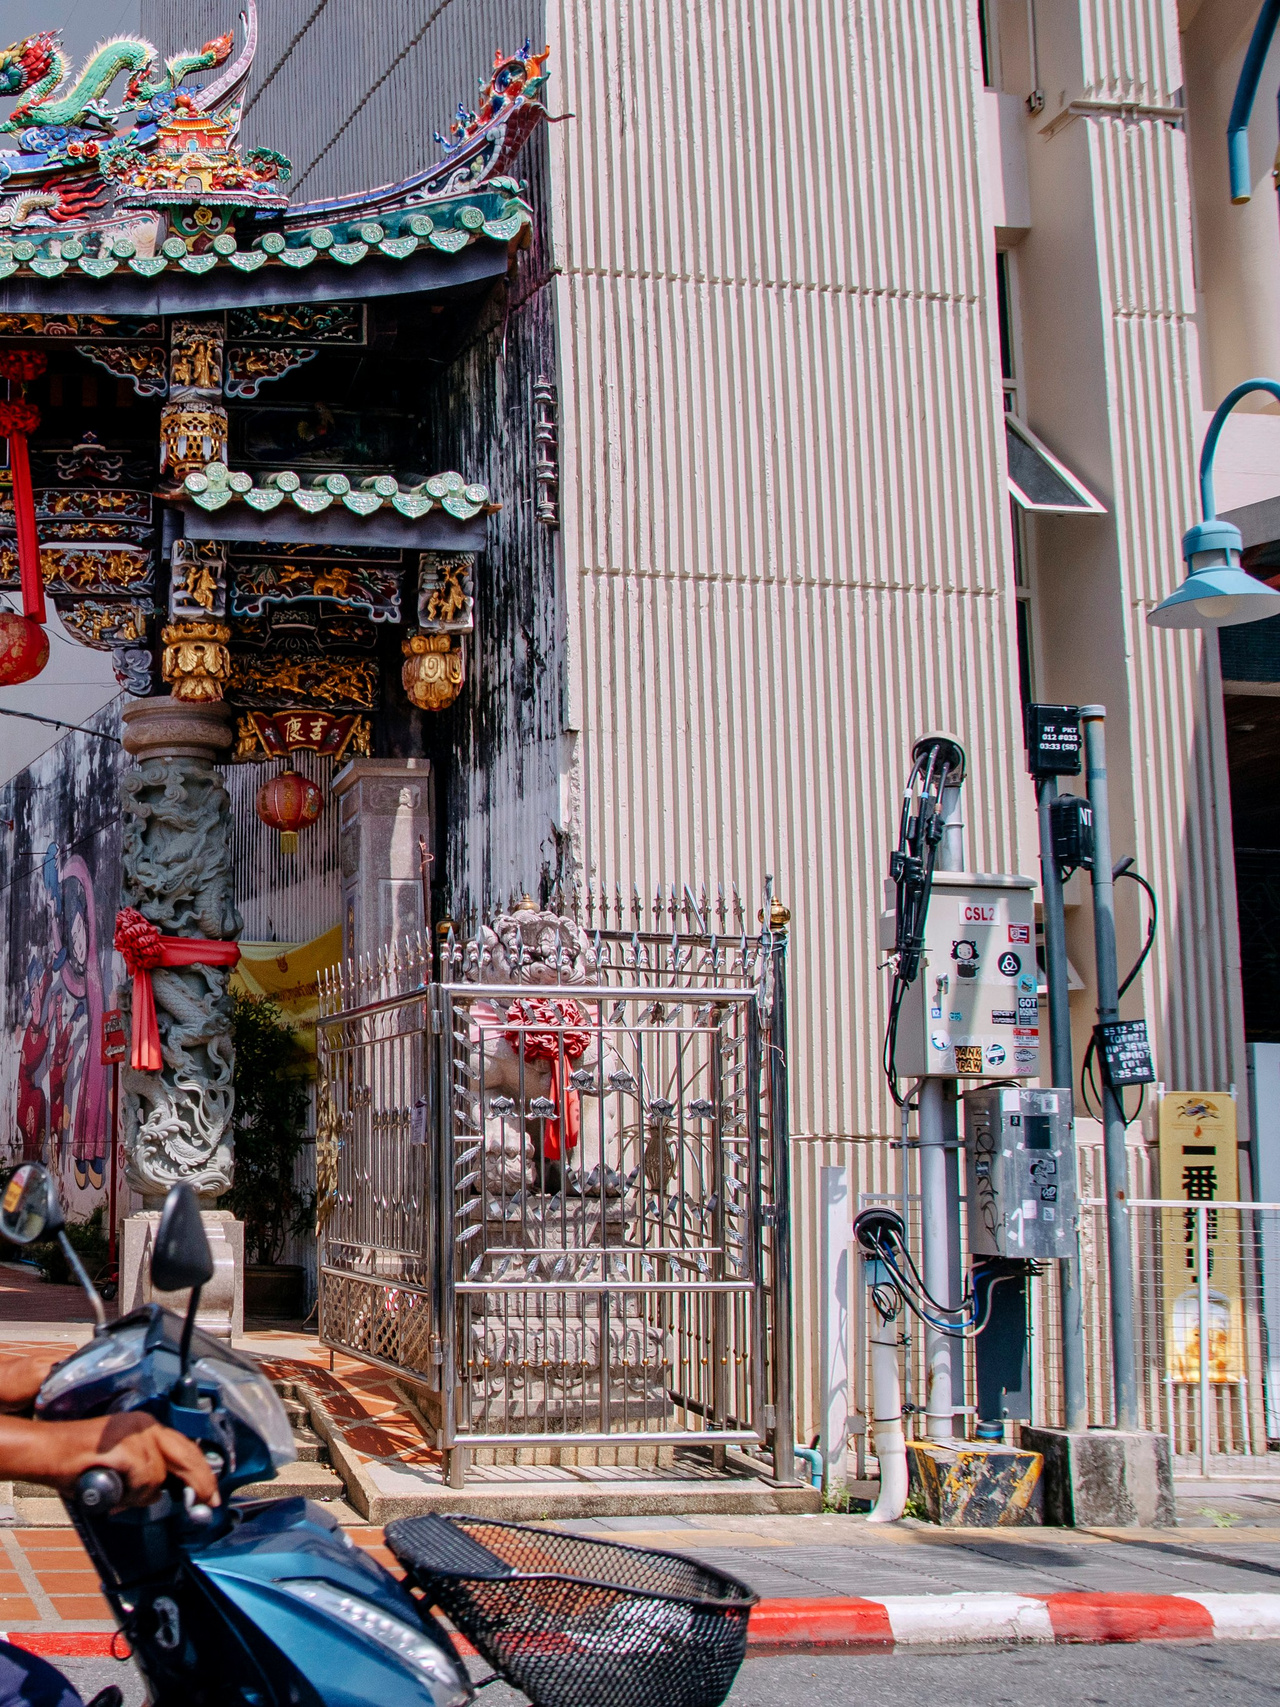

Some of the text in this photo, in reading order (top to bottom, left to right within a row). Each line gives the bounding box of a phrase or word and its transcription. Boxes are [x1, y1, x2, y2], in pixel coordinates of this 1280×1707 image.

[1041, 733, 1057, 741] 012
[1079, 807, 1093, 827] NT
[964, 907, 995, 921] CSL2
[1019, 998, 1037, 1008] GOT
